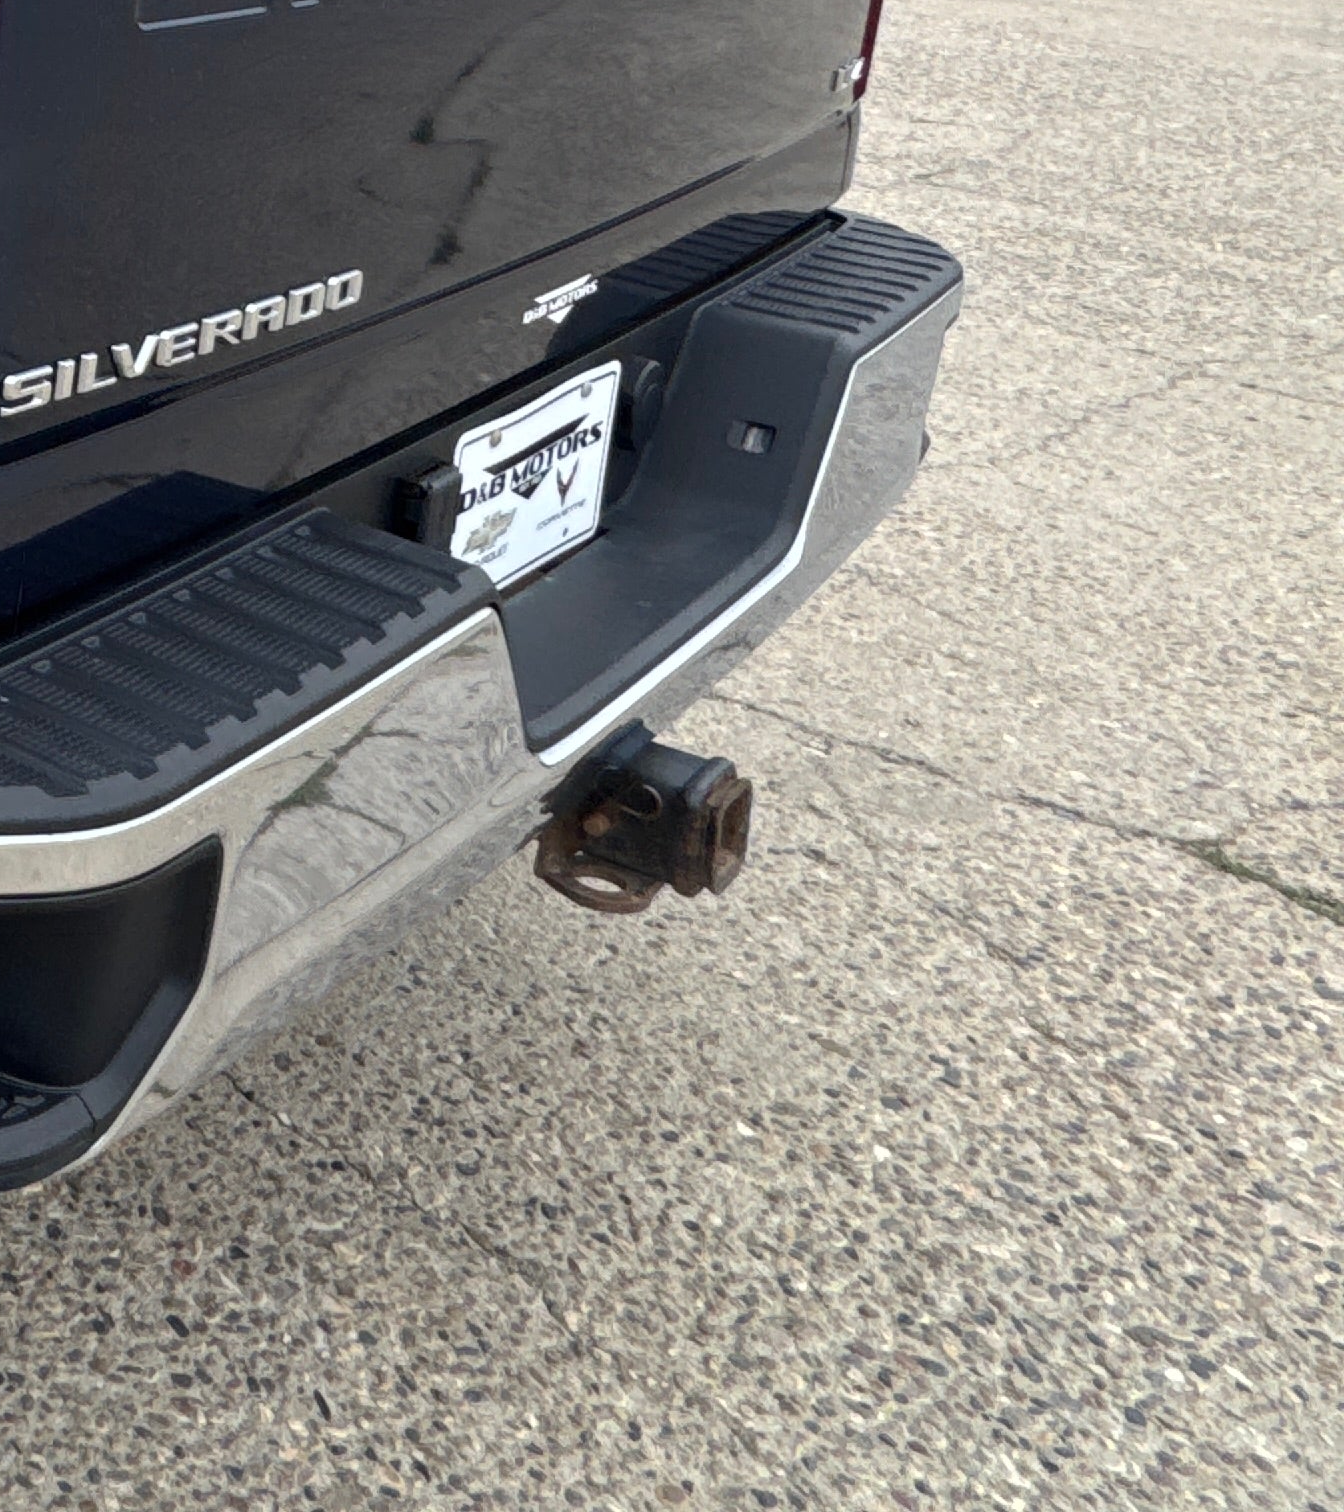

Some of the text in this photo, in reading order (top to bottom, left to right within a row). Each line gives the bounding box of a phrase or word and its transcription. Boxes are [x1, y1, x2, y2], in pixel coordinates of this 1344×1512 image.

[549, 278, 599, 311] MOTORS
[460, 420, 603, 514] D&B MOTORS
